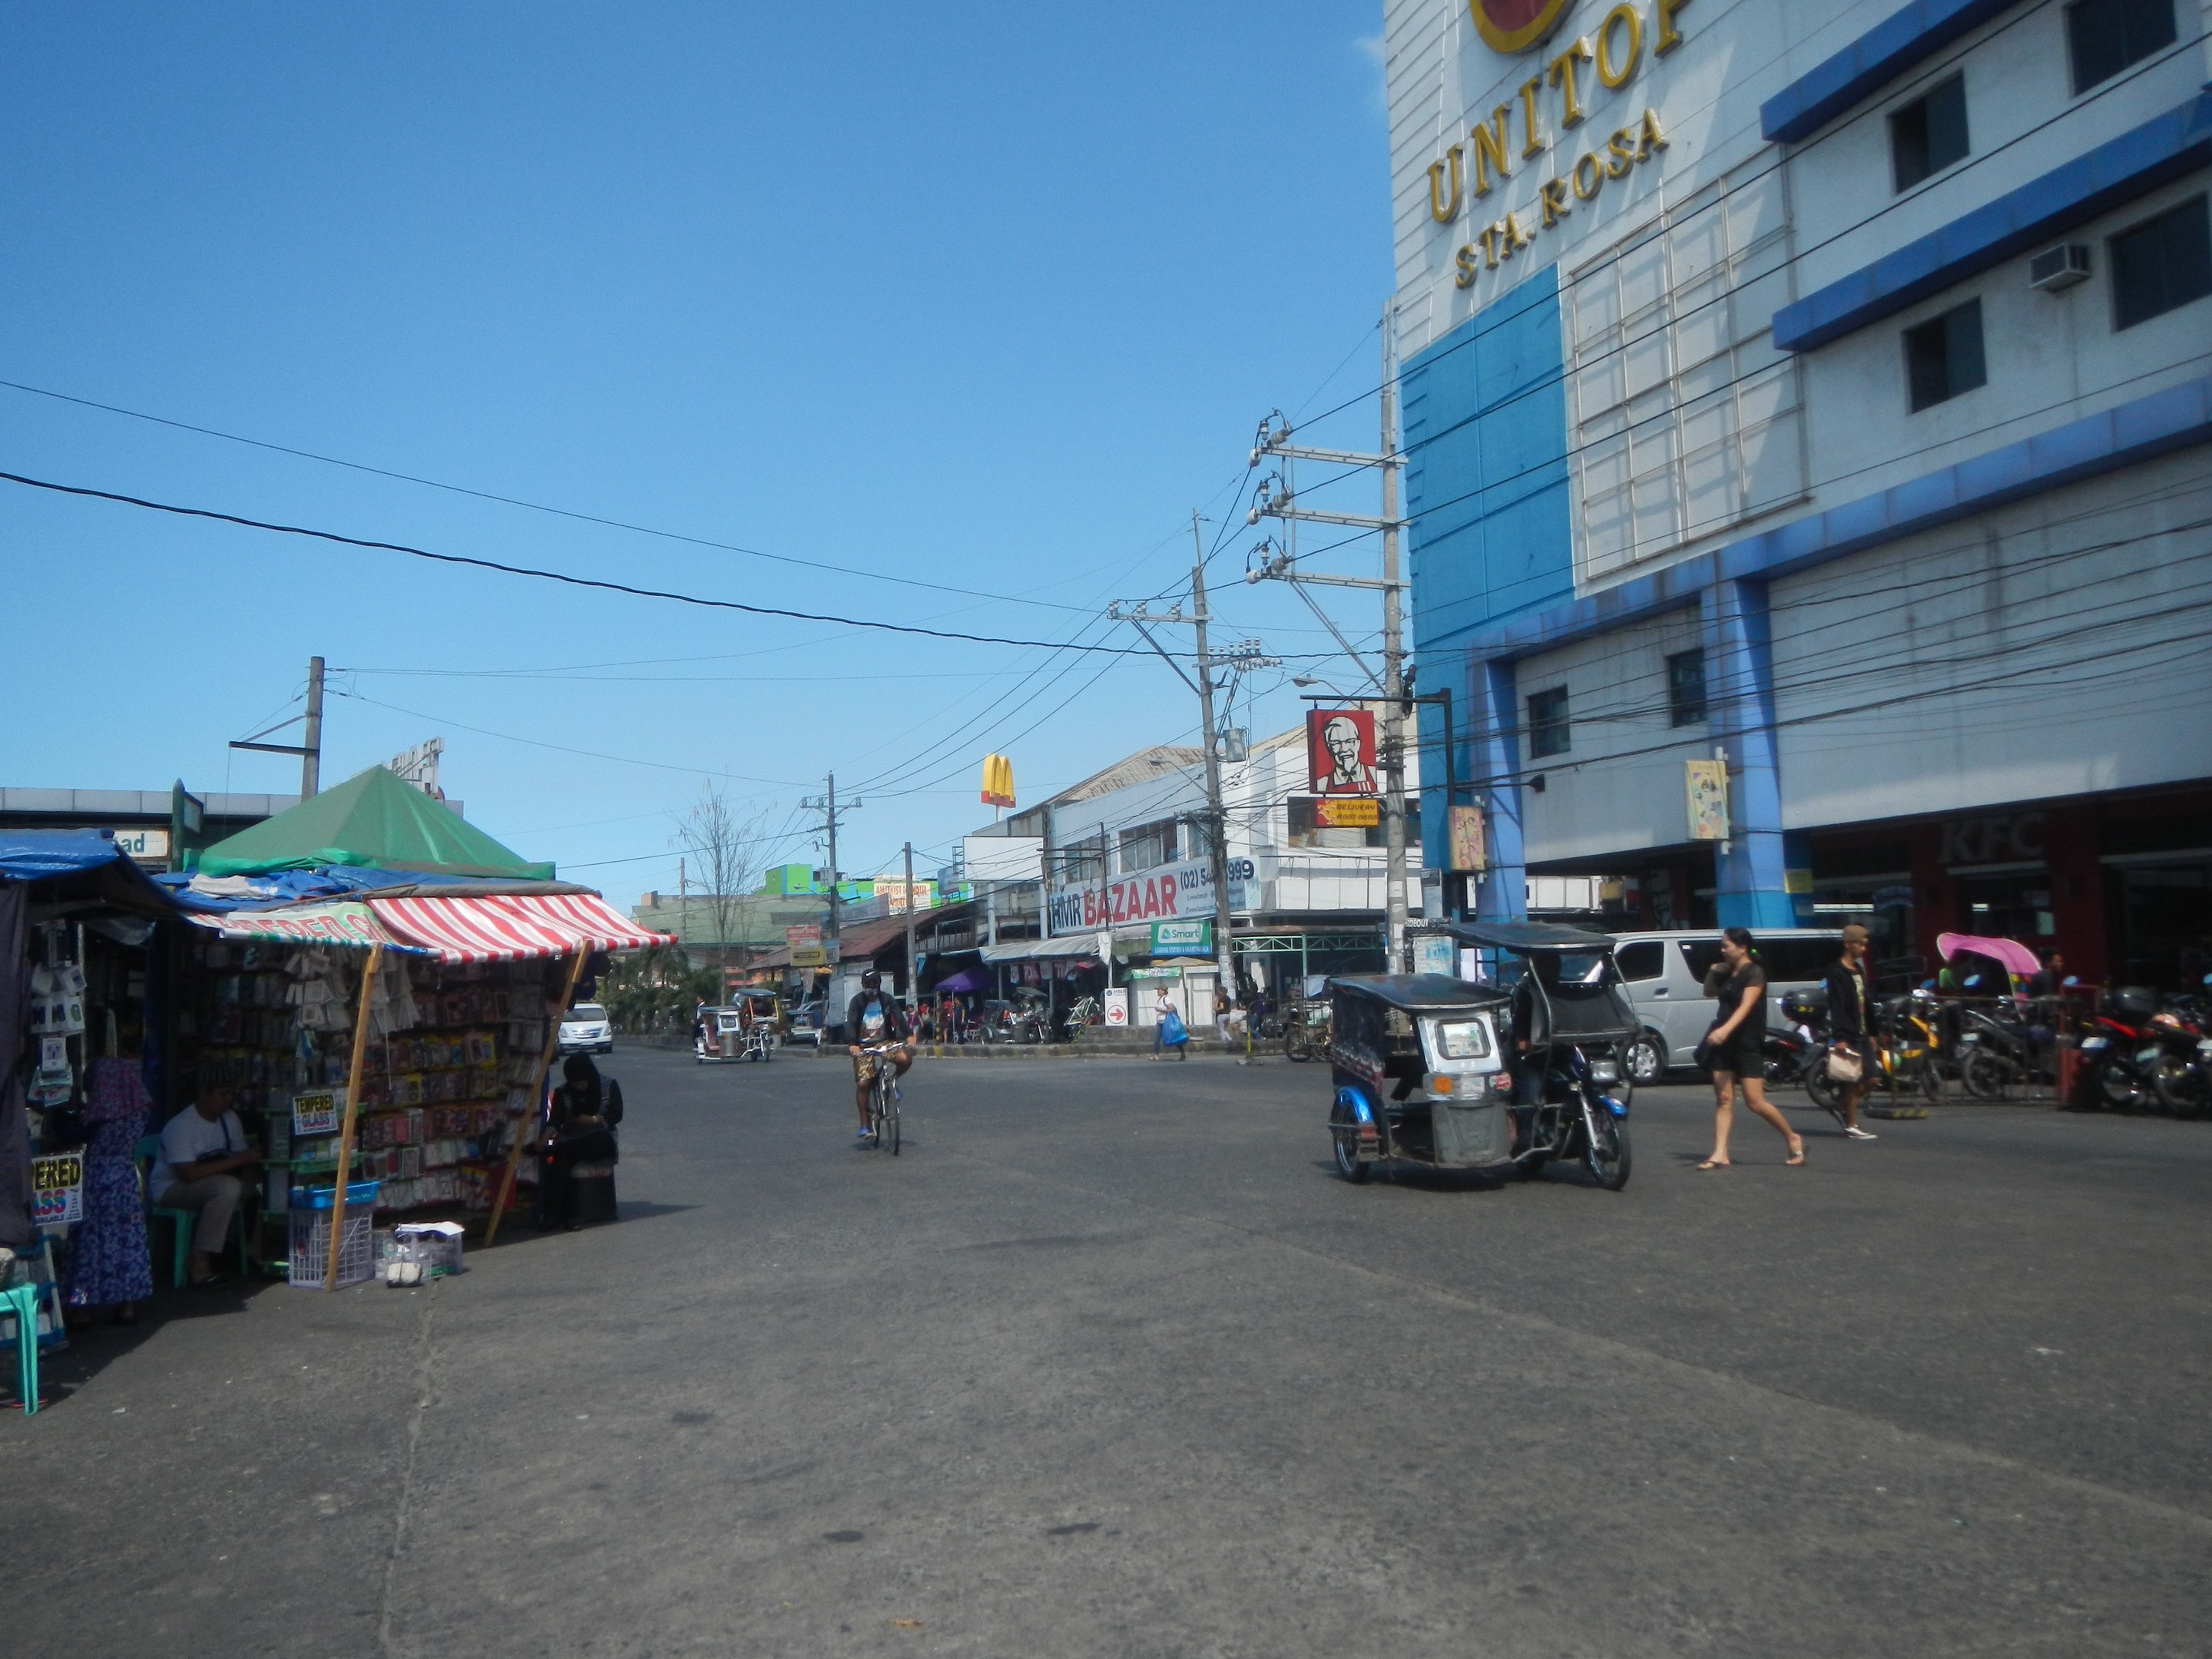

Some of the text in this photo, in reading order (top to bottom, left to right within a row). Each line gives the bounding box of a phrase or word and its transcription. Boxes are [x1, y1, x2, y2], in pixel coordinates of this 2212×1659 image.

[1455, 108, 1670, 289] STA. ROSA
[1938, 812, 2046, 865] KFC
[1181, 868, 1198, 891] (02)
[1083, 874, 1177, 926] BAZAAR
[1172, 929, 1199, 939] Smart
[295, 1094, 334, 1114] TEMPERED
[302, 1111, 330, 1128] GLASS
[33, 1158, 81, 1190] ERED
